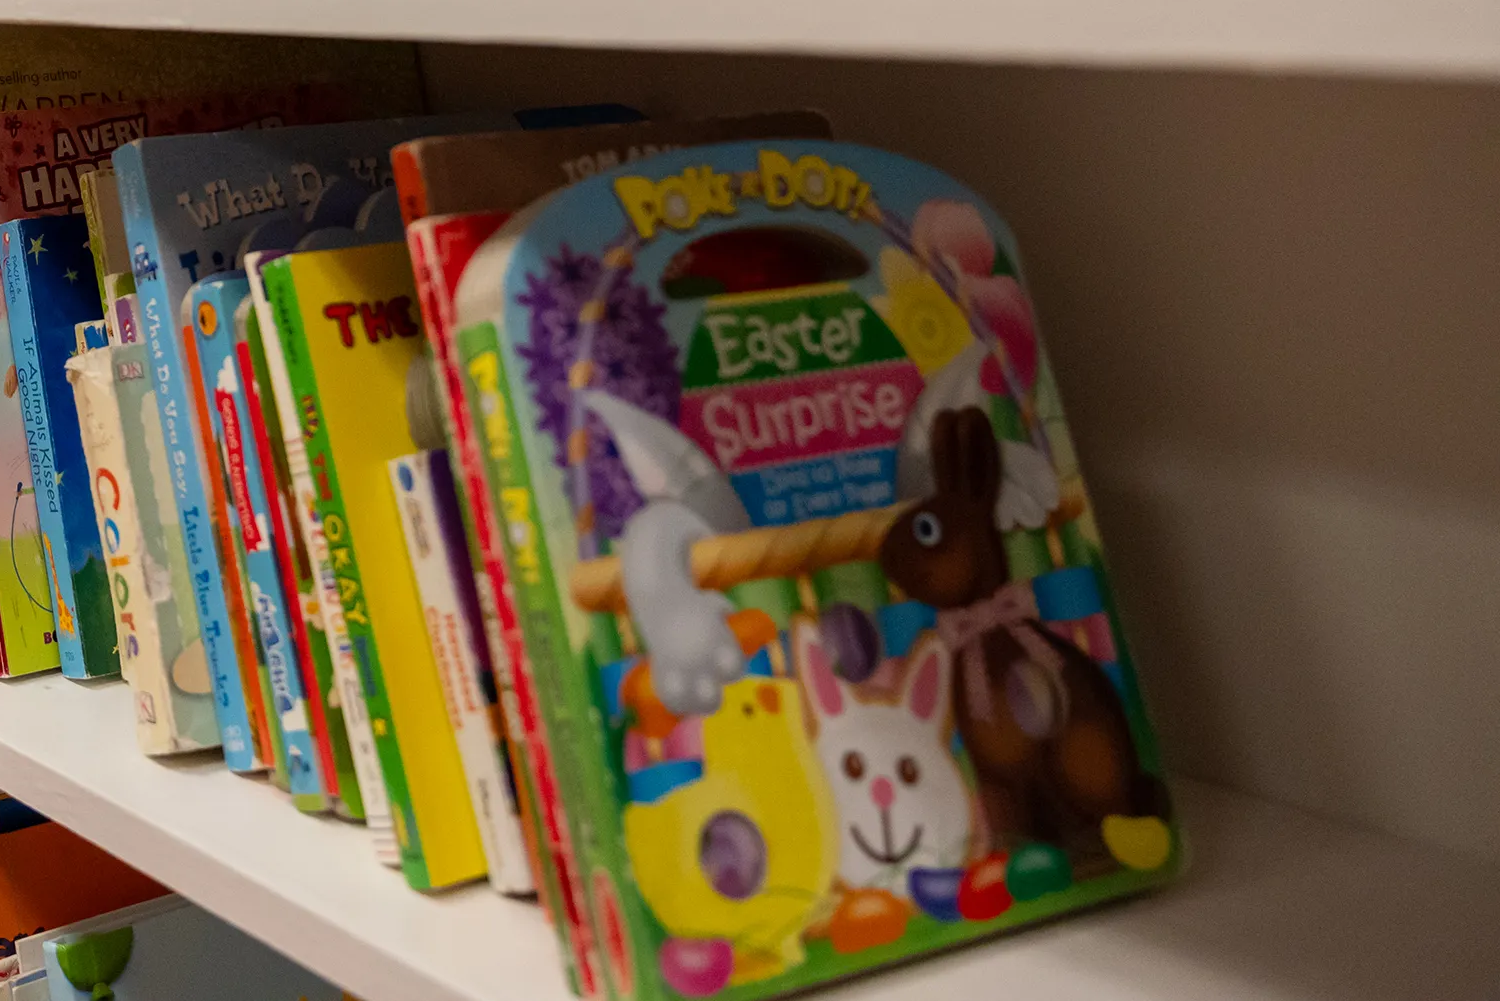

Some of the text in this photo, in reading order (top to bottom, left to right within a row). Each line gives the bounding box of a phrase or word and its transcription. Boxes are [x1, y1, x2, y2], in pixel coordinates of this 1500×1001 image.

[43, 68, 83, 83] author
[55, 115, 148, 159] A VERY
[177, 173, 288, 229] What
[324, 295, 419, 348] THE
[704, 307, 867, 378] Easter
[144, 297, 161, 361] What
[156, 364, 168, 395] Do
[164, 399, 177, 446] You
[17, 367, 41, 486] Good Night
[23, 338, 58, 513] If Animals Kissed
[702, 381, 904, 469] Surprise
[195, 568, 211, 616] Blue
[323, 513, 367, 626] OKAY
